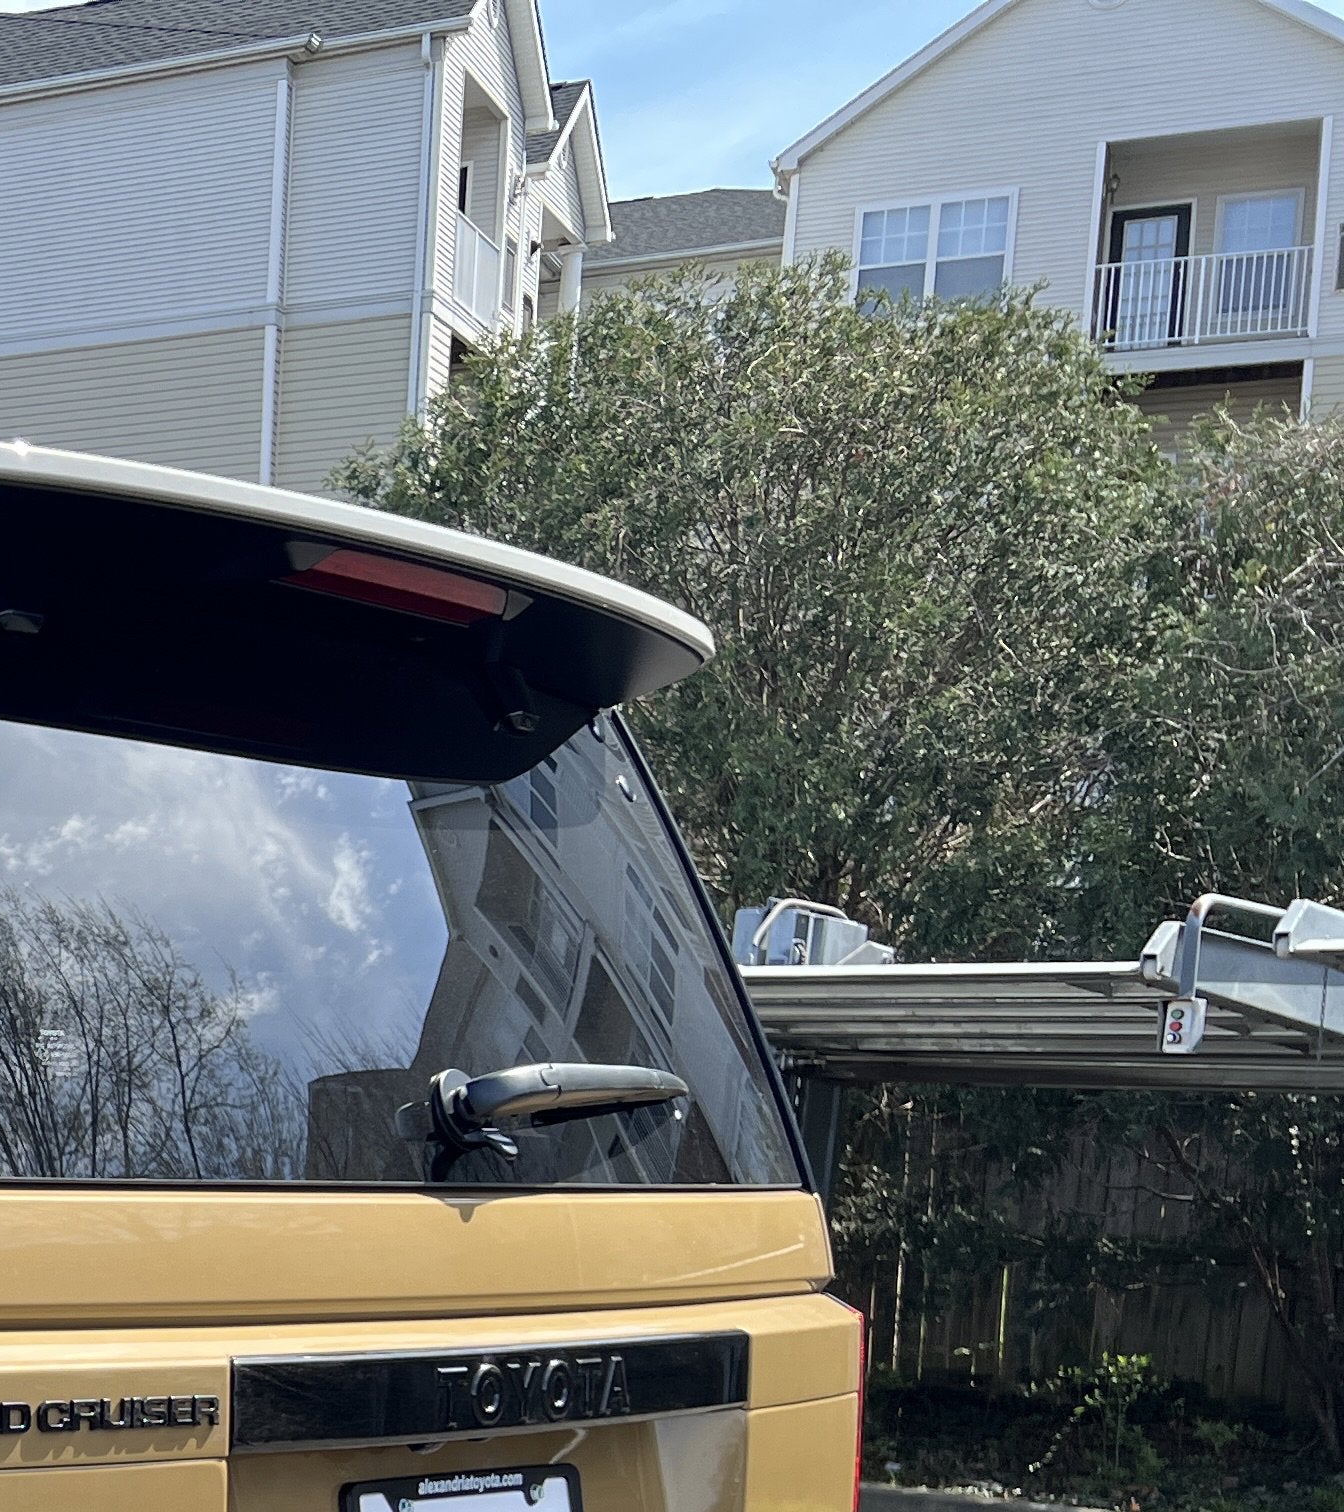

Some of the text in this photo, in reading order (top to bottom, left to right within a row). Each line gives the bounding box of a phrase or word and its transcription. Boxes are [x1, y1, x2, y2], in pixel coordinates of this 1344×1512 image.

[437, 1355, 631, 1428] TOYOTA
[37, 1394, 220, 1432] CRUISER
[417, 1471, 524, 1496] alexandriatoyota.com
